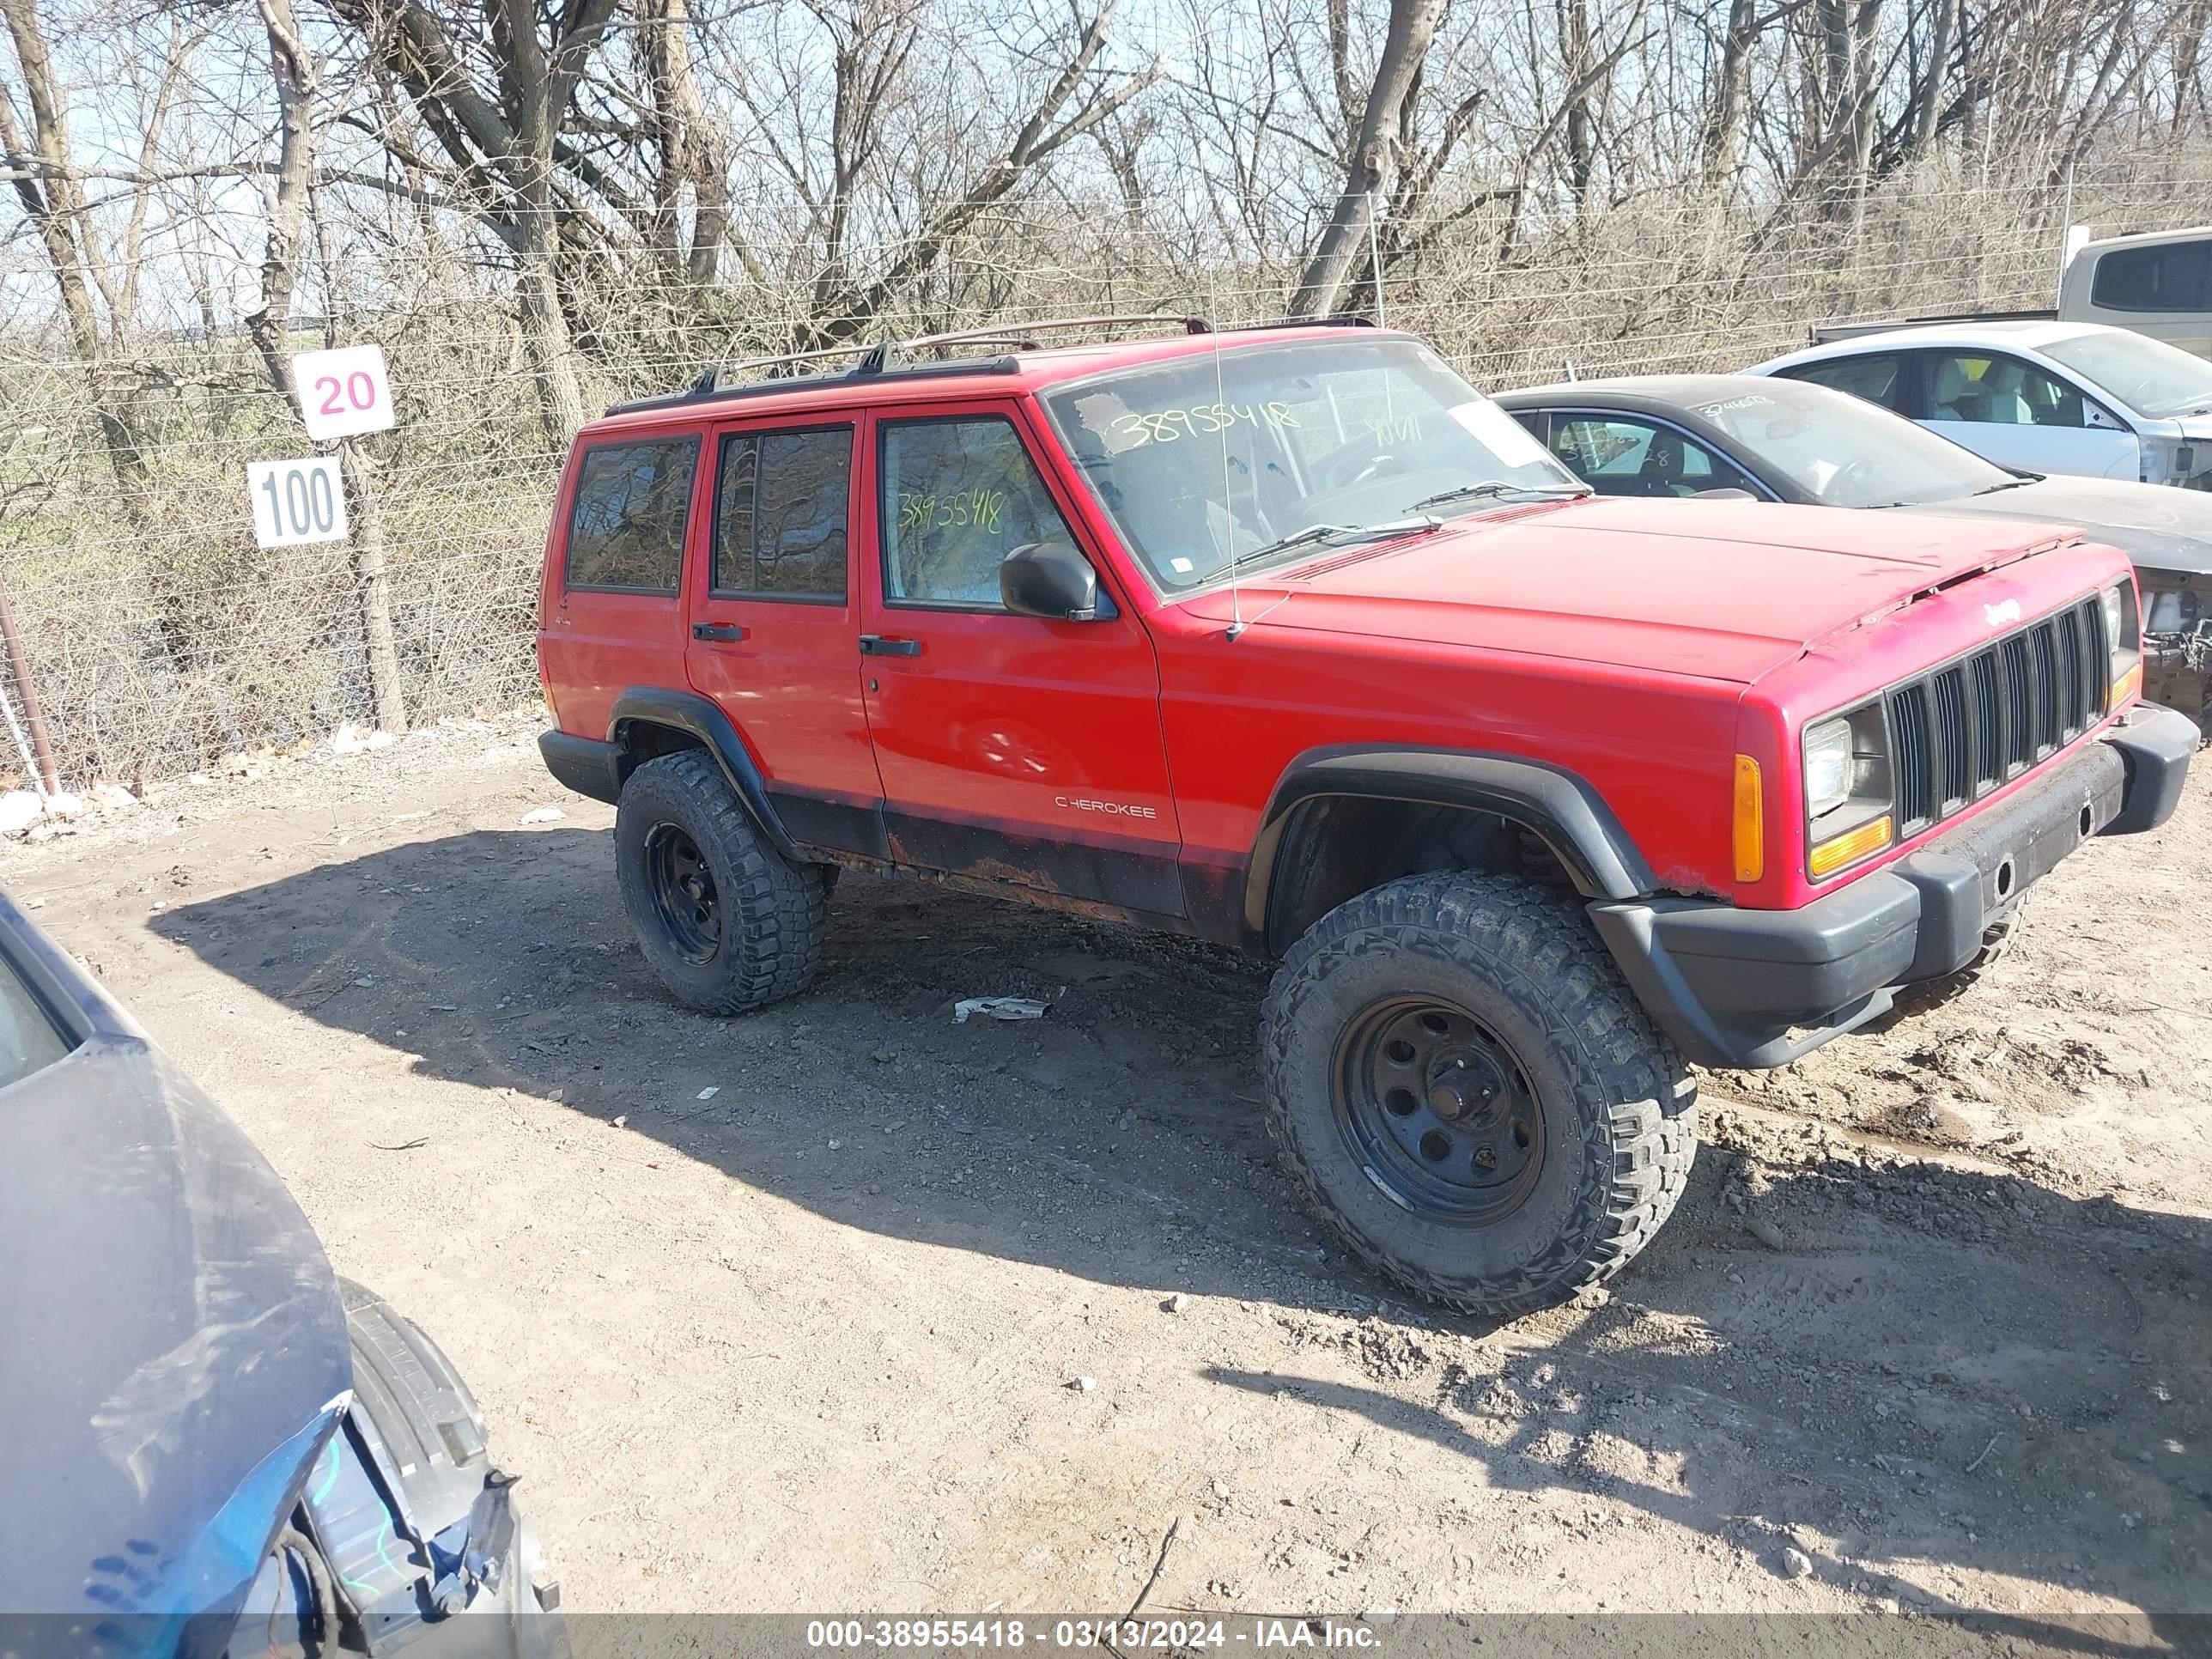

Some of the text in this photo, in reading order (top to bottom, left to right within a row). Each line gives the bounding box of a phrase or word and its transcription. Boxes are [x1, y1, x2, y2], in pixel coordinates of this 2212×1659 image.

[314, 372, 375, 416] 20
[1110, 401, 1302, 447] 38955418
[261, 467, 334, 537] 100
[1054, 796, 1157, 819] CHEROKEE
